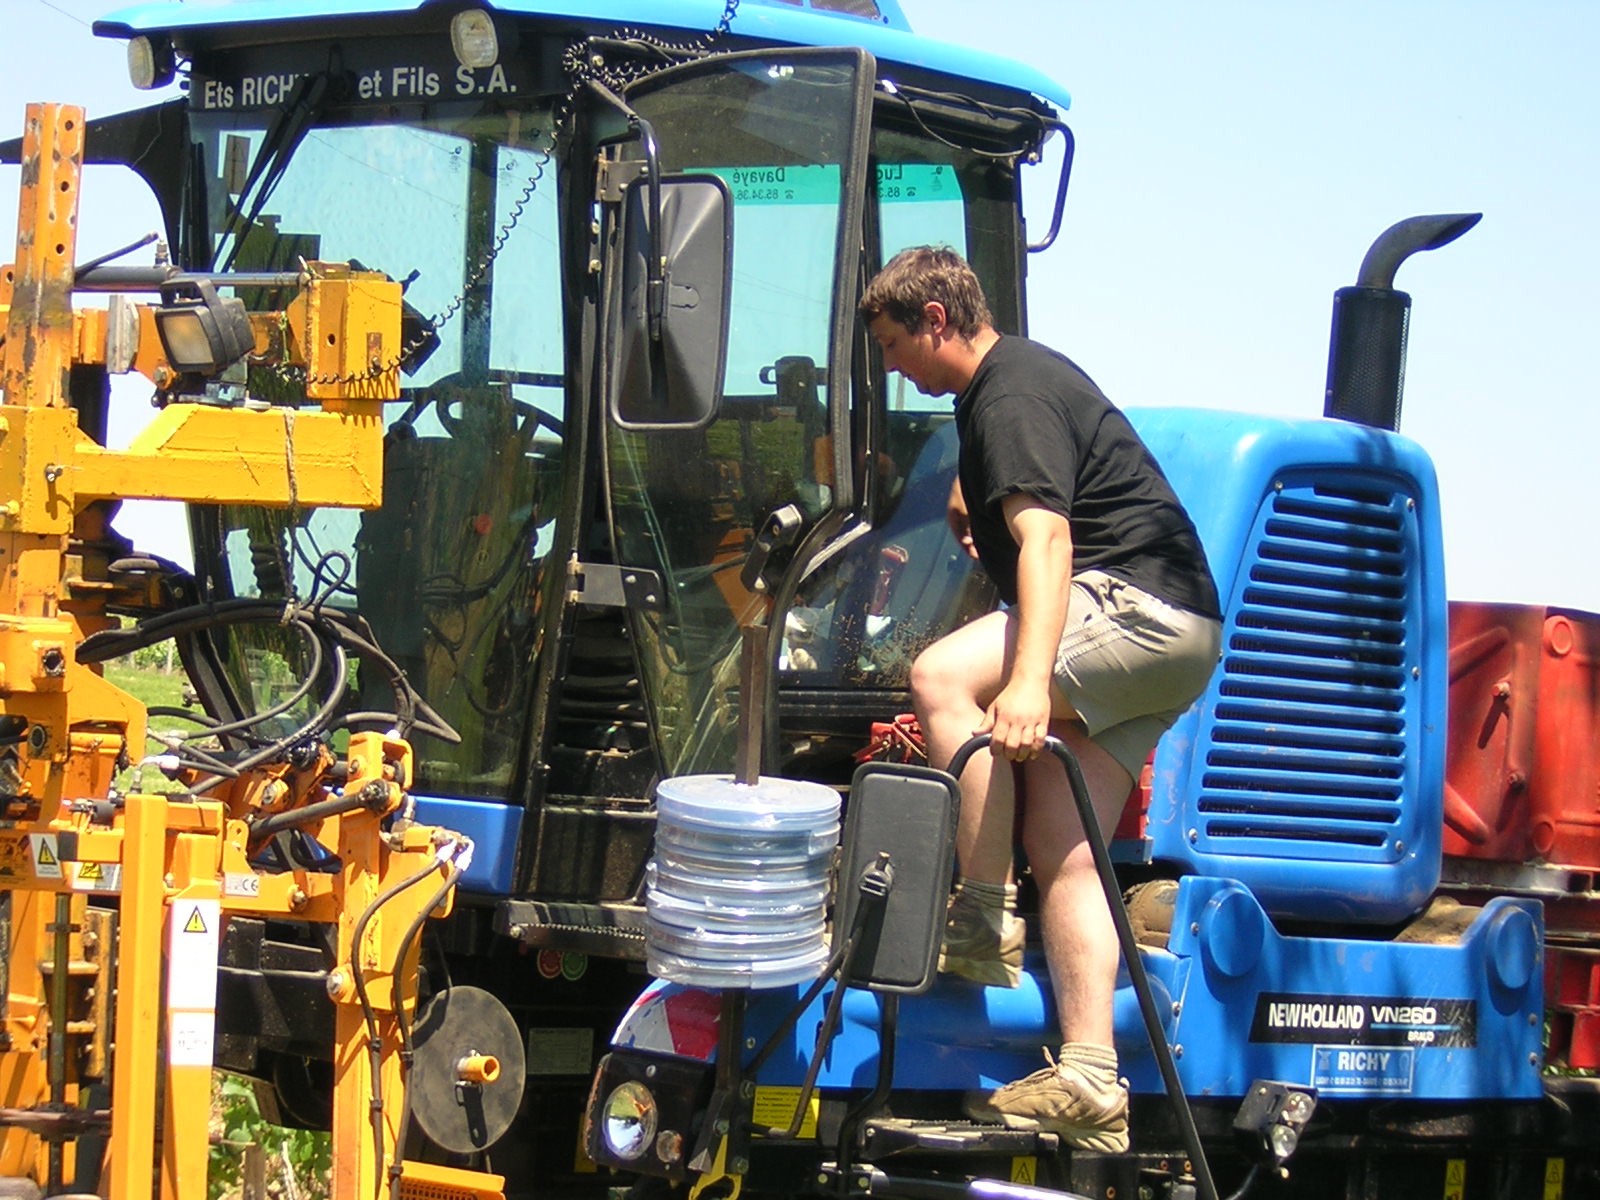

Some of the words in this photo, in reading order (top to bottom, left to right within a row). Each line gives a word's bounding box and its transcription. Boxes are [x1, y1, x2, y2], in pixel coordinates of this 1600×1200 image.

[204, 80, 234, 109] Ets
[242, 73, 309, 106] RICH
[358, 71, 383, 99] et
[392, 66, 440, 98] Fils
[455, 64, 517, 95] S.A.
[1371, 1006, 1437, 1025] VN260
[1337, 1051, 1390, 1072] RICHY
